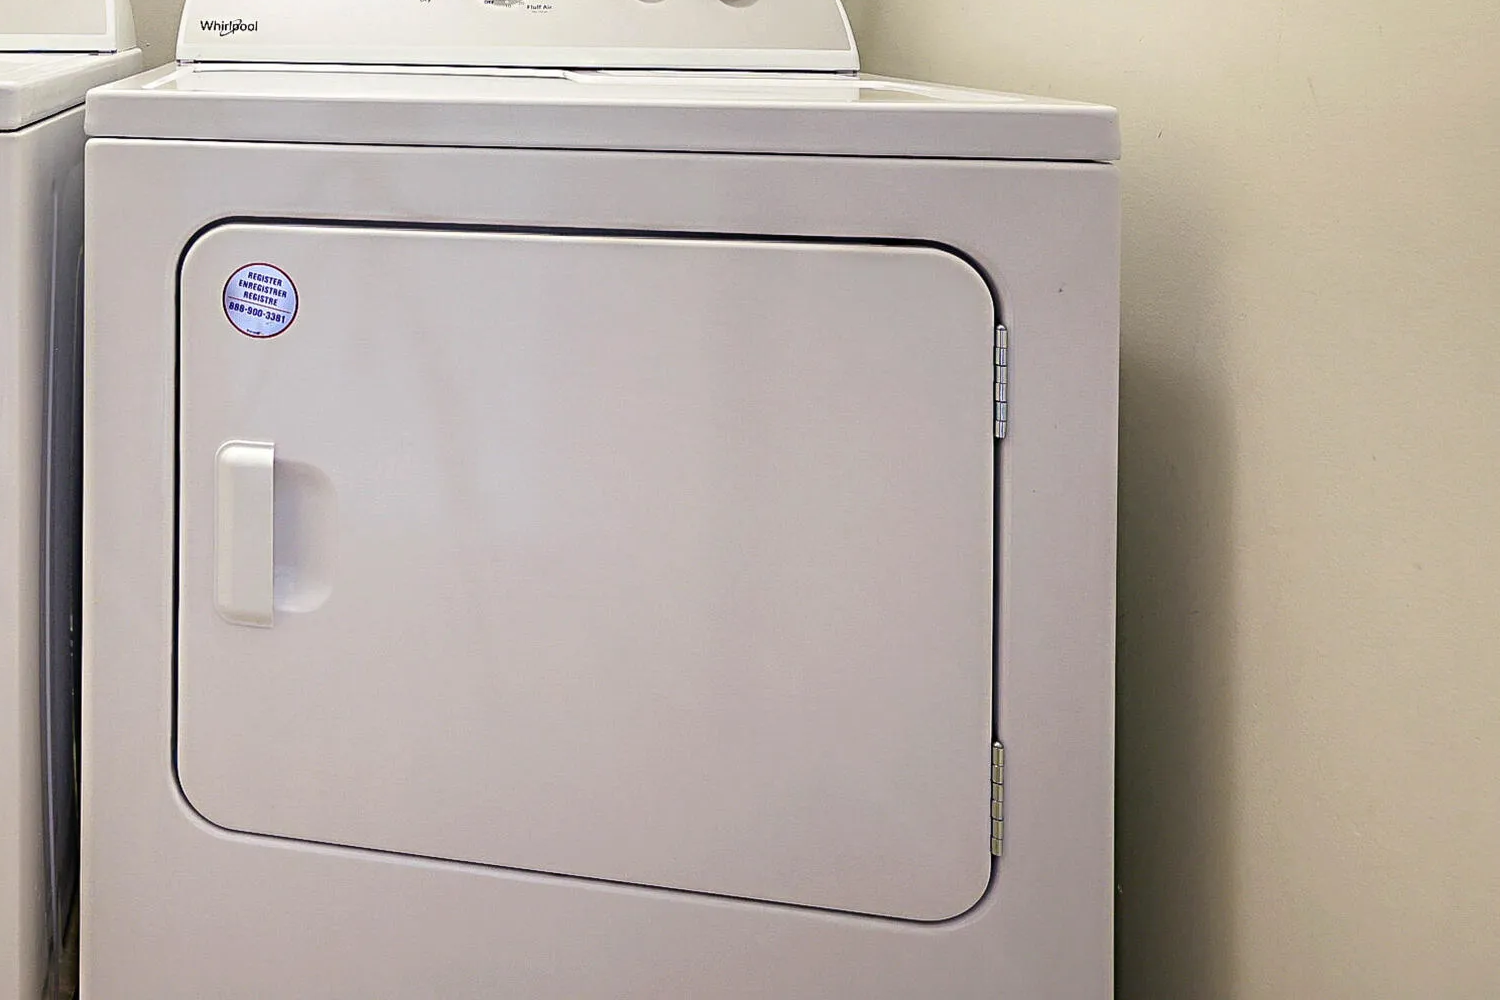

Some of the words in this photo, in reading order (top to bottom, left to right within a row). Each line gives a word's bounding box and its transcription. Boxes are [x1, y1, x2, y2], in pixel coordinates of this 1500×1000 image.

[200, 18, 258, 37] Whirlpool
[247, 271, 283, 287] REGISTER
[238, 279, 288, 298] ENREGISTRER
[243, 290, 278, 306] REGISTRE
